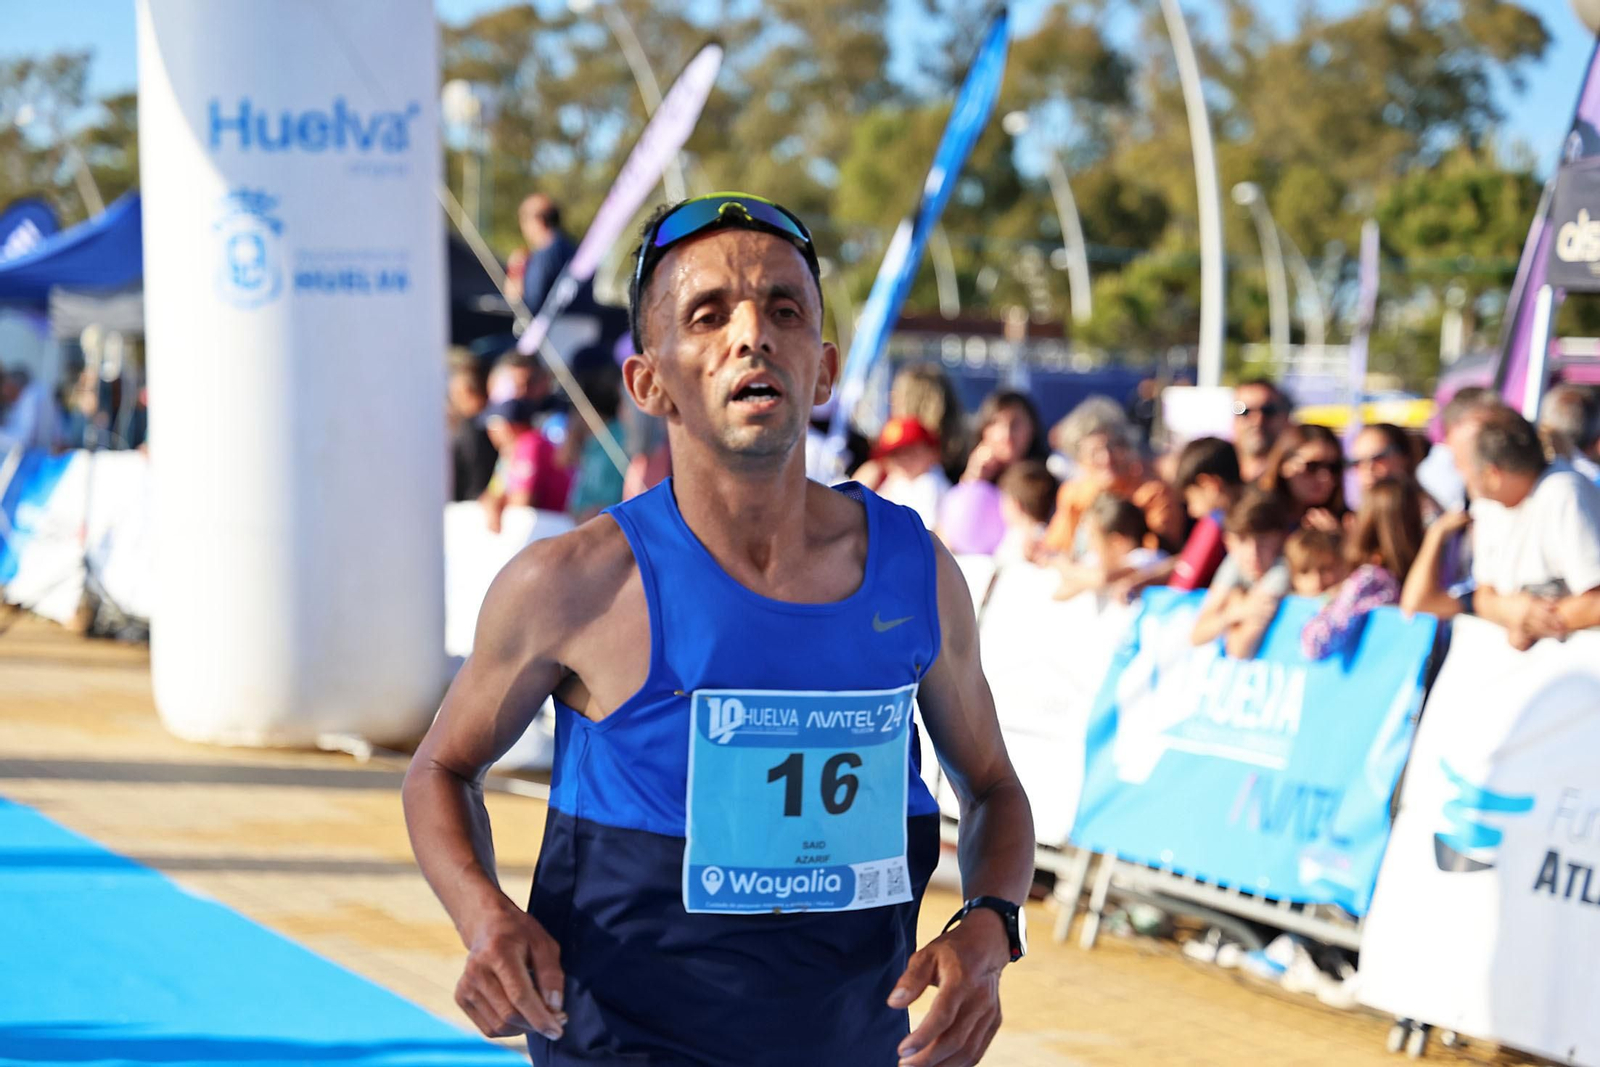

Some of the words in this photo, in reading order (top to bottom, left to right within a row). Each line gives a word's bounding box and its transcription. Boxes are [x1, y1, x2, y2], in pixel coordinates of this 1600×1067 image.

[208, 97, 409, 152] Huelva
[743, 708, 799, 727] HUELVA
[805, 710, 875, 729] AVATEL
[767, 752, 862, 817] 16
[795, 855, 831, 866] AZARIF
[802, 841, 826, 851] SAID
[728, 868, 842, 899] Wayalia
[1533, 849, 1600, 907] ATL
